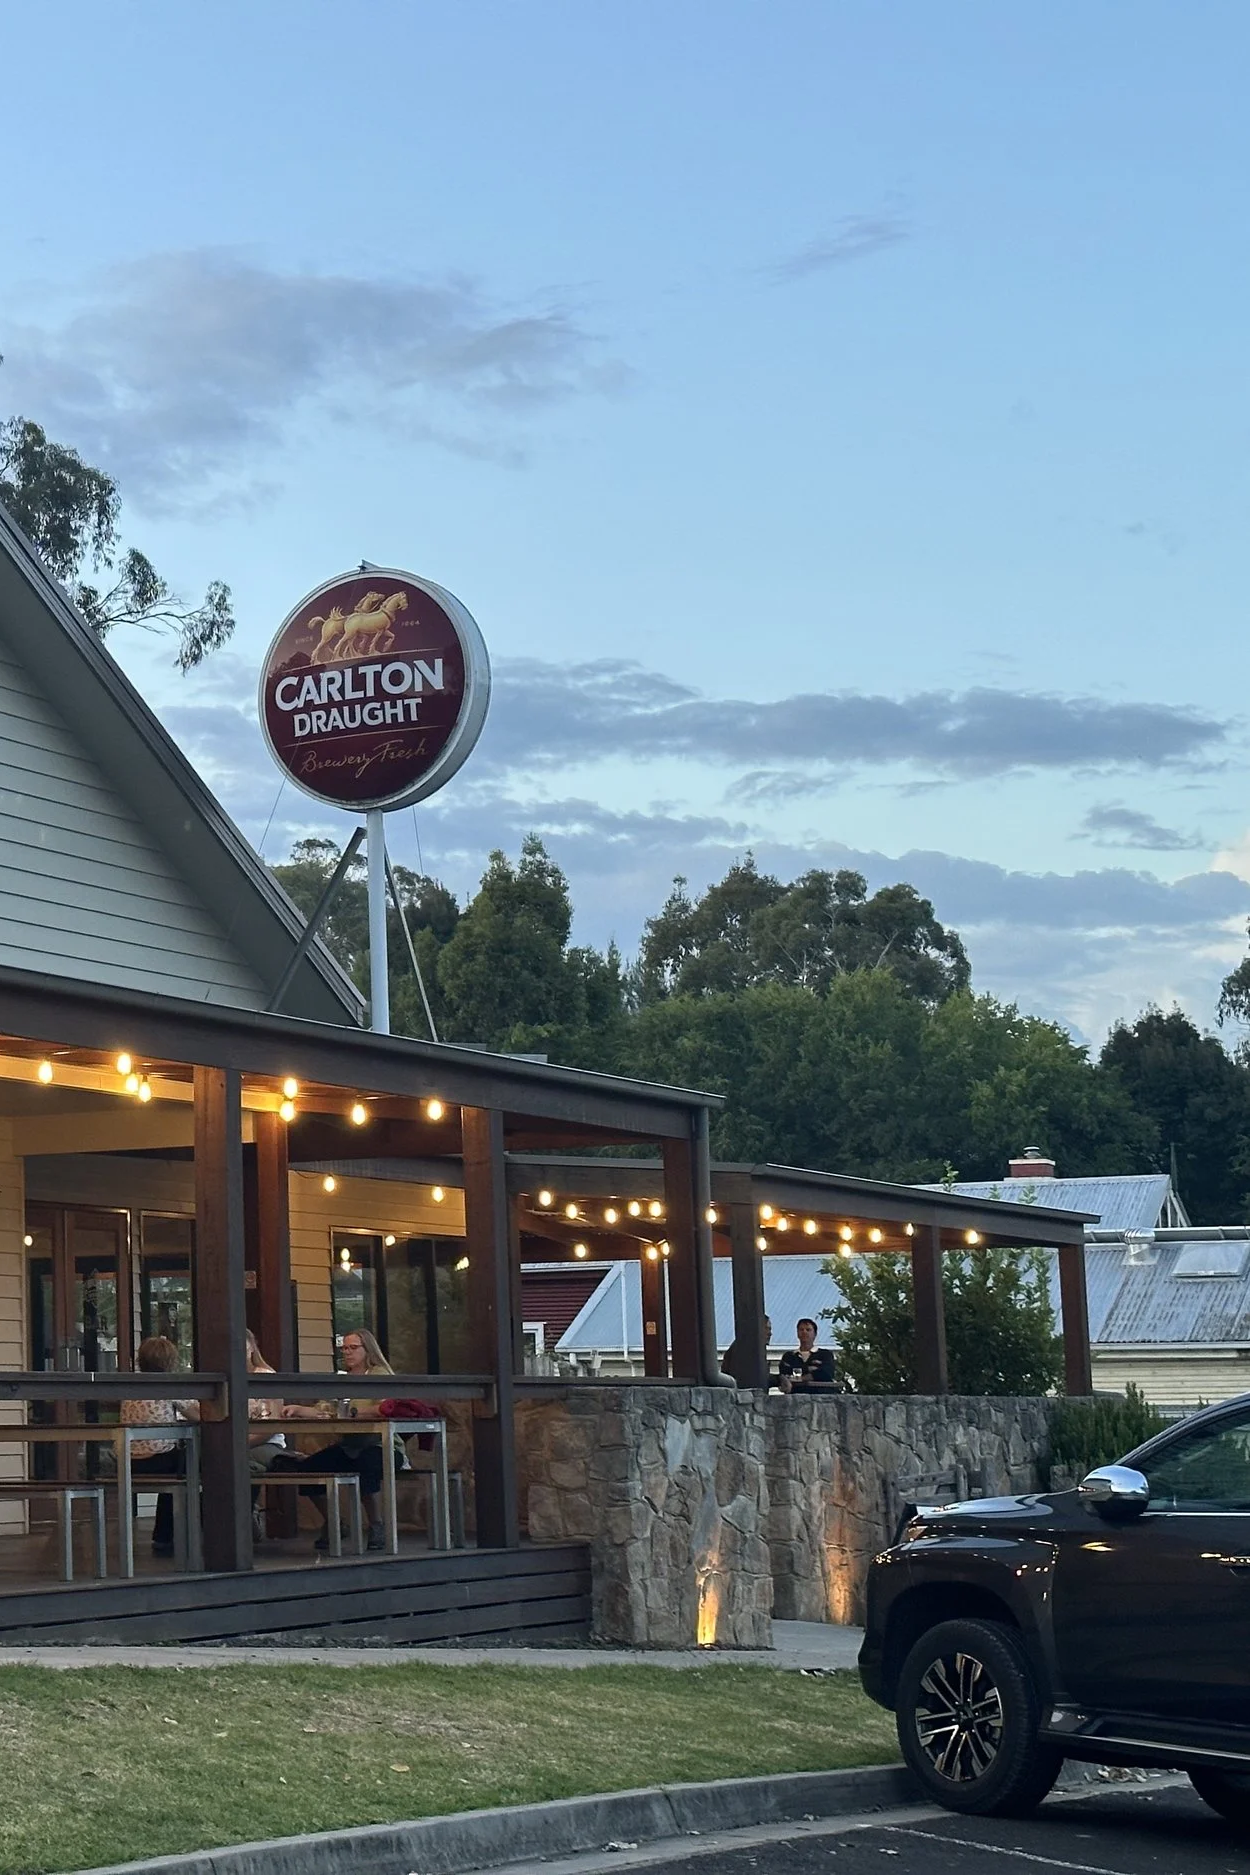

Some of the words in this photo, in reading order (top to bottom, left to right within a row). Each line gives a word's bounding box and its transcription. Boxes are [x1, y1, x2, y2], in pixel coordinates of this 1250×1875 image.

[275, 658, 444, 711] CARLTON
[293, 698, 422, 737] DRAUGHT
[300, 750, 374, 779] Brewery
[373, 738, 428, 762] Fresh
